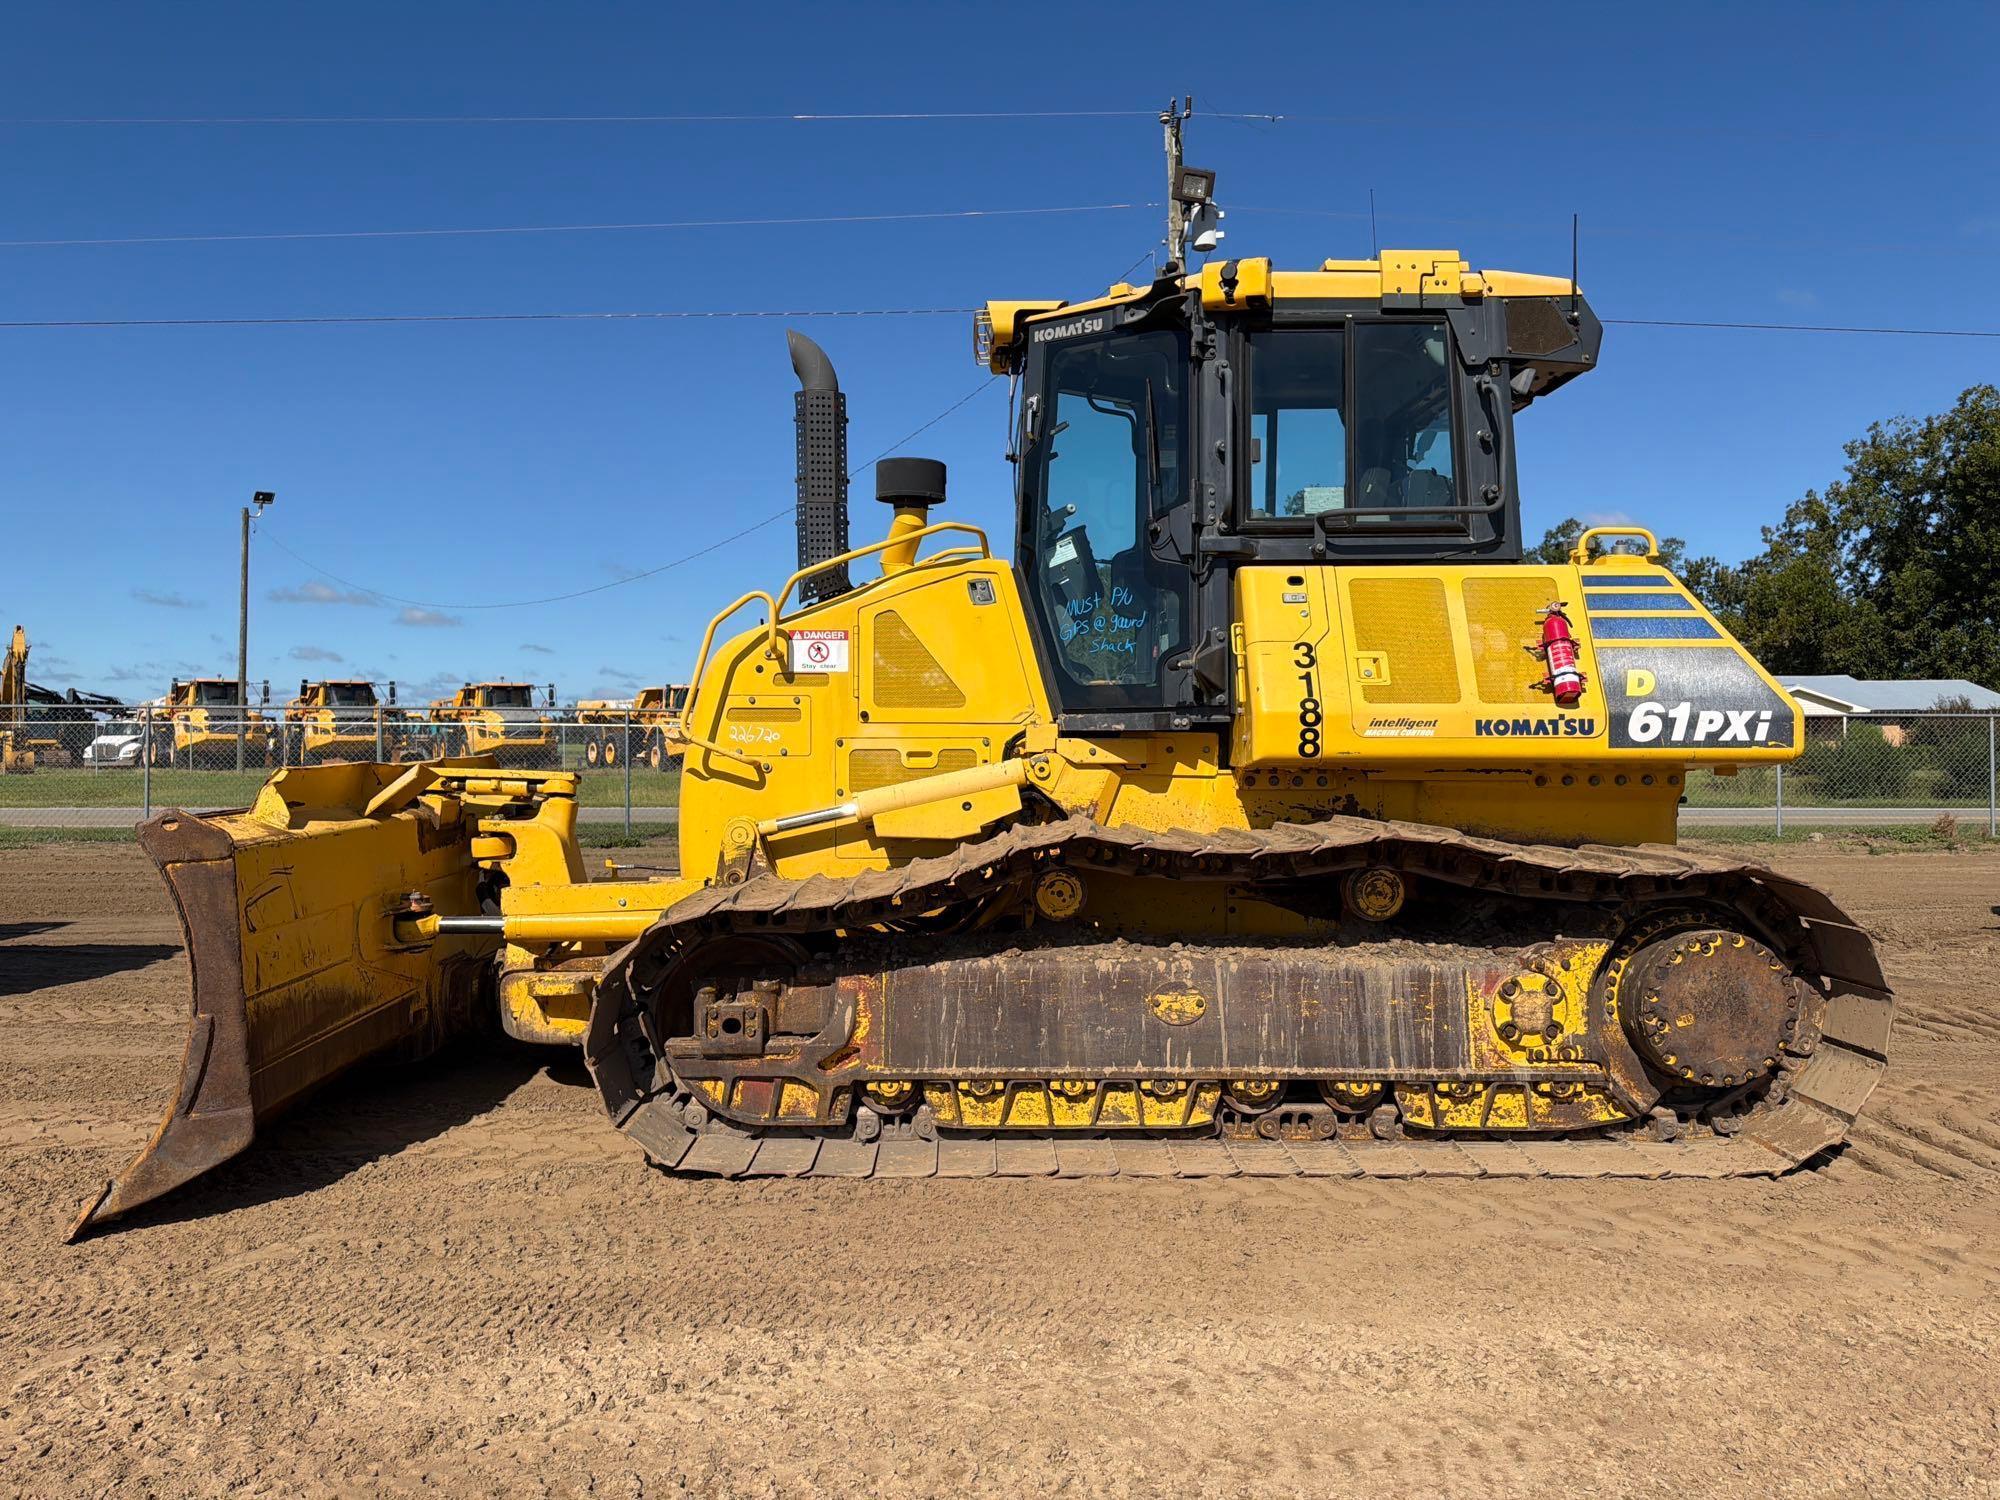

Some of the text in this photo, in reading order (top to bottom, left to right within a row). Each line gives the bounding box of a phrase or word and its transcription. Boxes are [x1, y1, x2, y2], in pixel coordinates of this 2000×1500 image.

[1034, 318, 1103, 343] KOMATSU
[803, 631, 845, 639] DANGER
[1060, 620, 1089, 640] GPS
[1094, 616, 1106, 632] @
[1626, 669, 1656, 696] D
[1293, 642, 1322, 758] 3188
[1369, 717, 1438, 729] intelligent
[1475, 714, 1595, 736] KOMATSU
[1627, 701, 1772, 743] 61PXi
